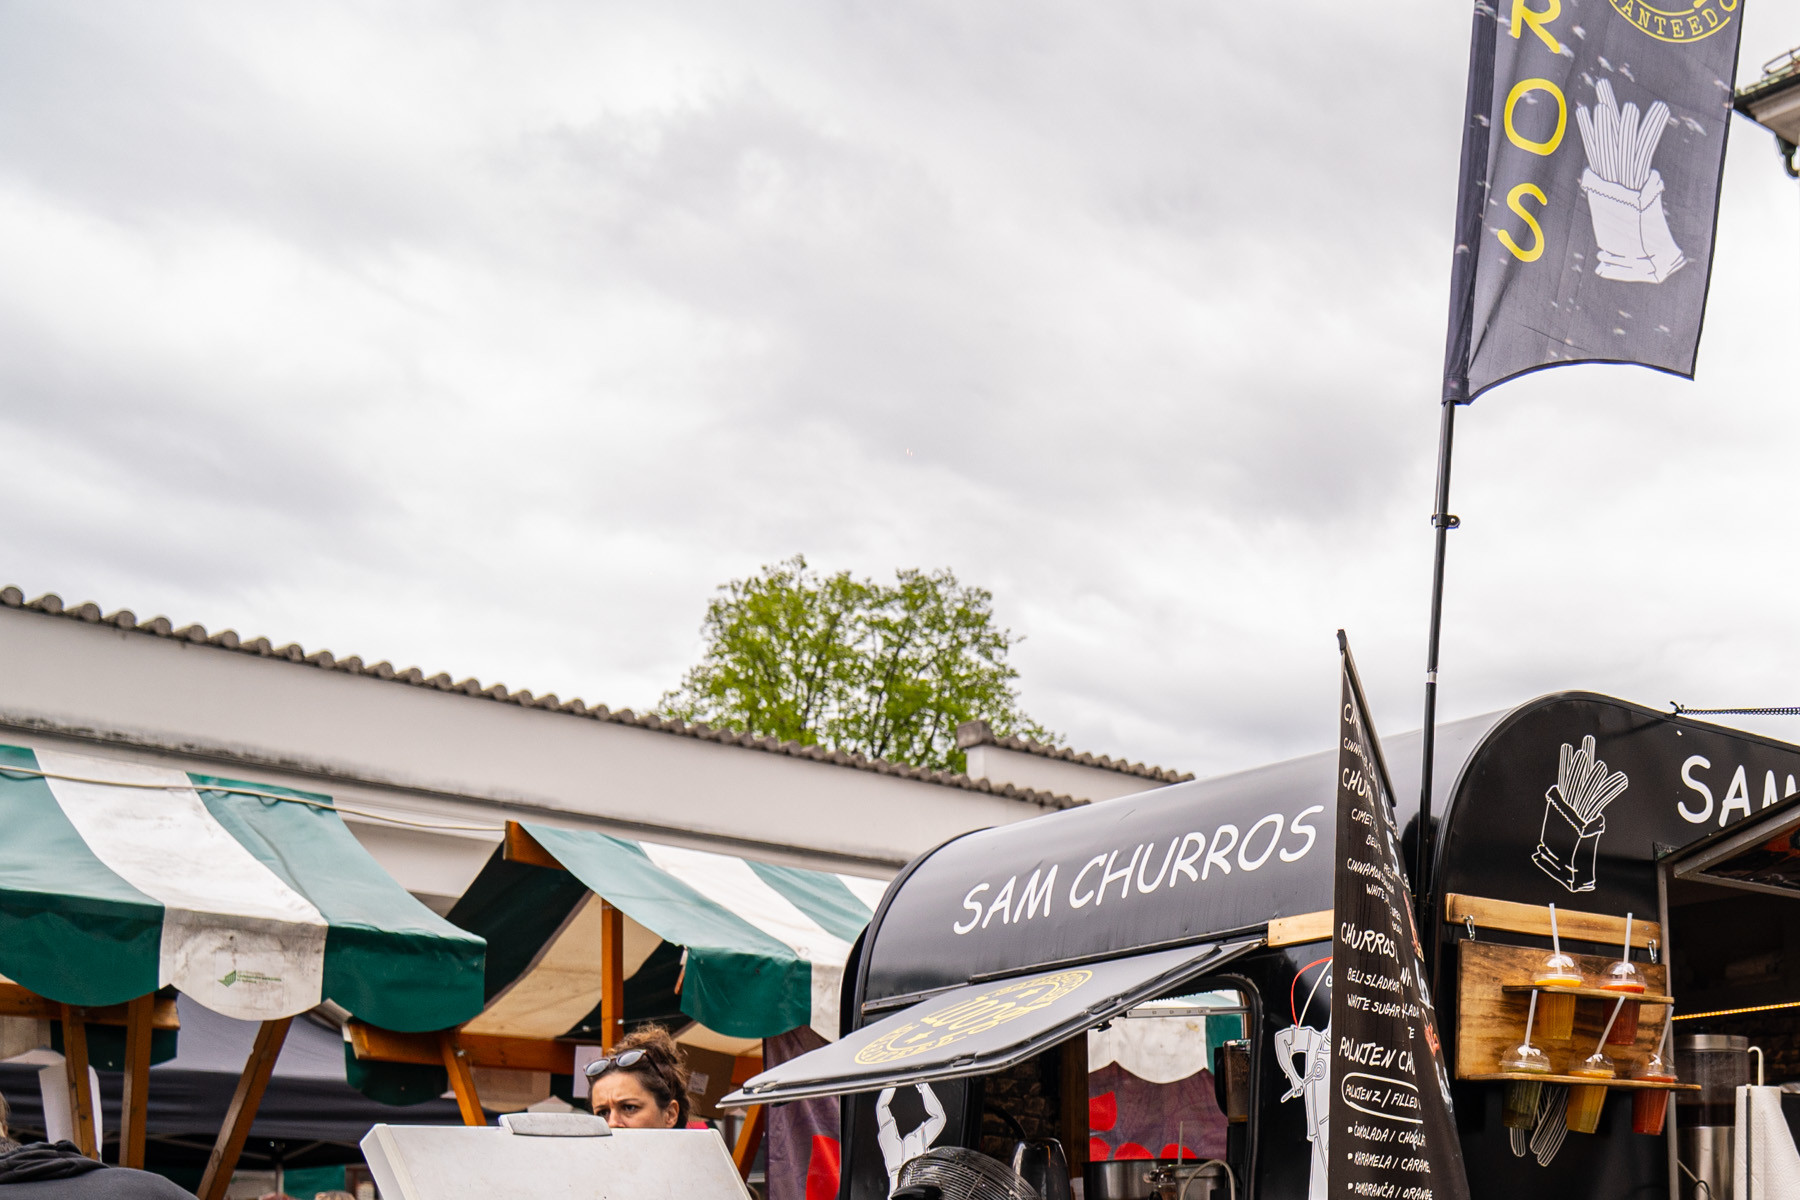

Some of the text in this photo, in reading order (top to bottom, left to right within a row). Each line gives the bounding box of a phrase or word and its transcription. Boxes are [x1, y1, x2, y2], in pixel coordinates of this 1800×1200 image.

[953, 863, 1059, 935] SAM
[1069, 804, 1325, 909] CHURROS
[1339, 1036, 1397, 1069] POLNJEN
